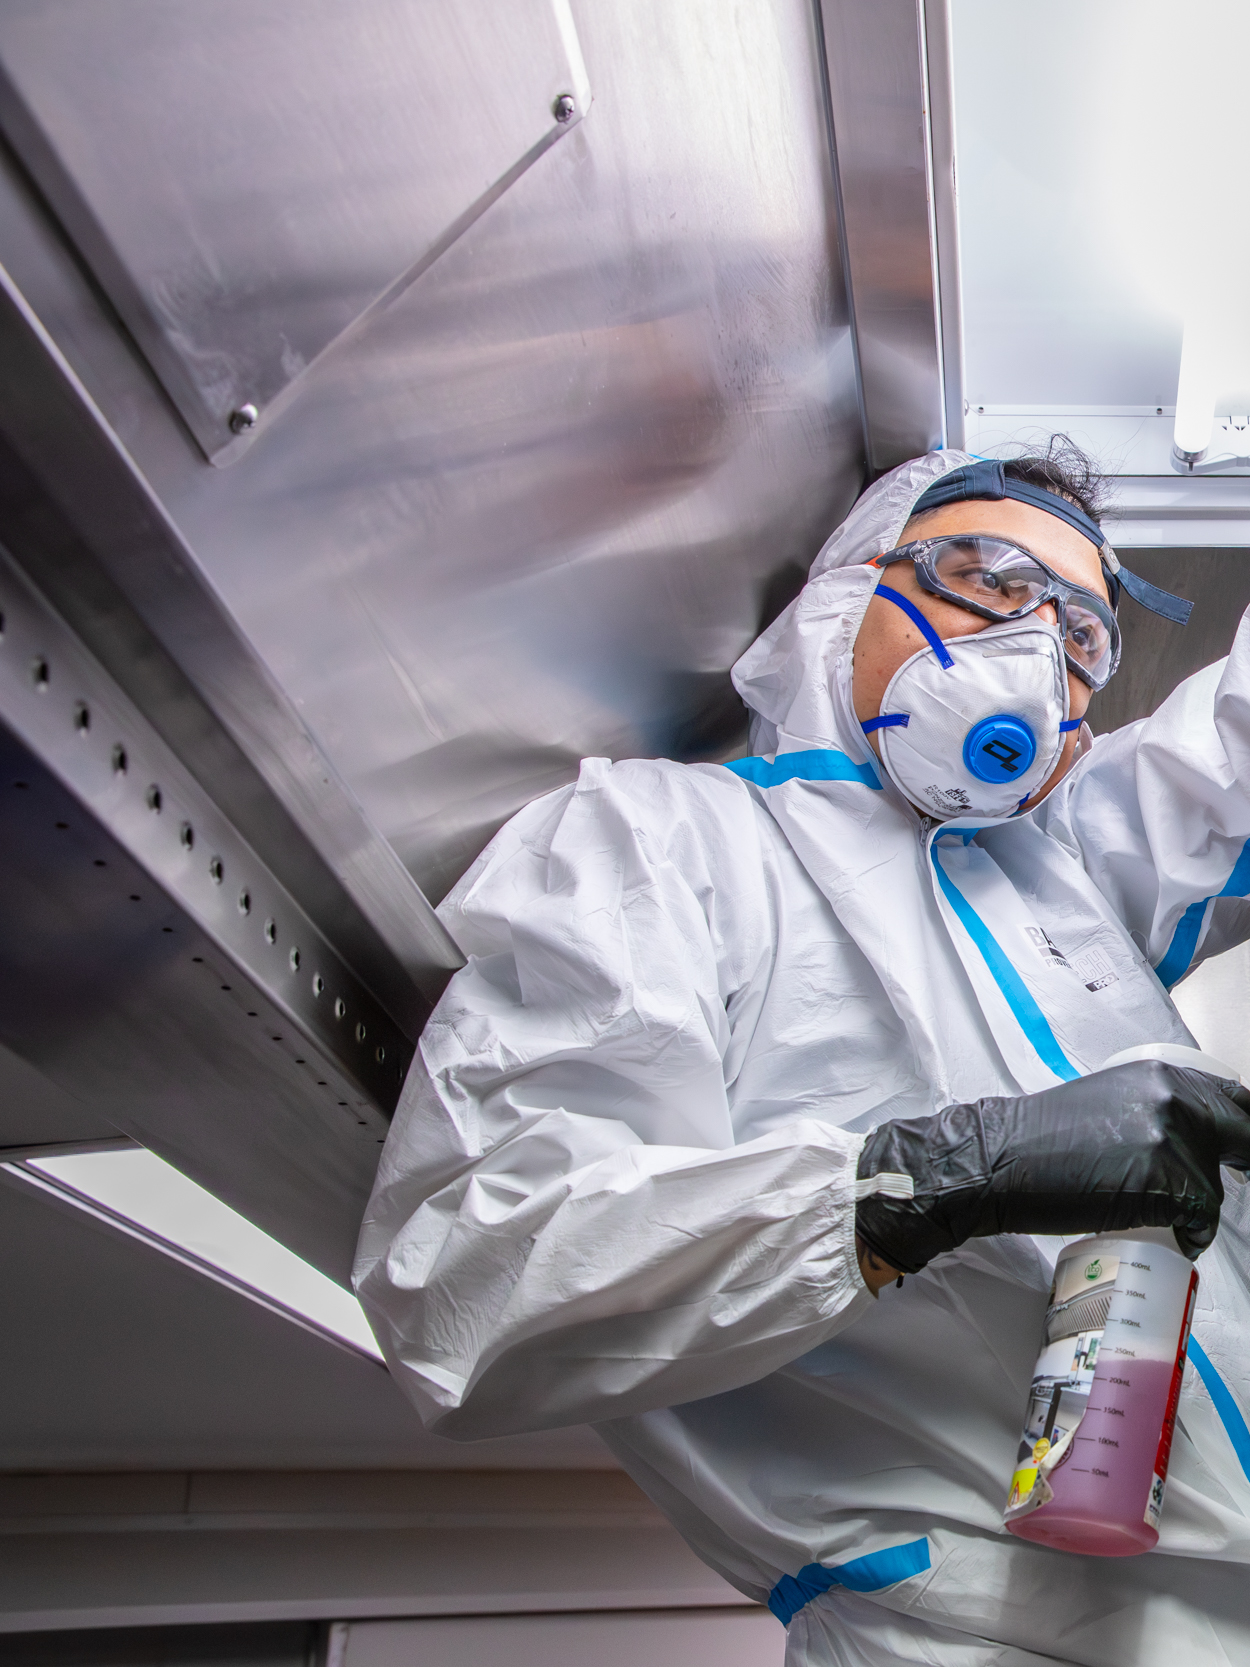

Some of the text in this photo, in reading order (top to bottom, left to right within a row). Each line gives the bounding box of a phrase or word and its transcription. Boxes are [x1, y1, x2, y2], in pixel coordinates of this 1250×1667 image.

[1130, 1261, 1152, 1271] 400mL
[1125, 1288, 1146, 1299] 350mL
[1120, 1318, 1141, 1328] 300mL
[1115, 1347, 1135, 1357] 250mL
[1109, 1376, 1130, 1387] 200mL
[1103, 1406, 1125, 1417] 150mL
[1098, 1437, 1119, 1448] 100mL
[1091, 1468, 1109, 1478] 50mL
